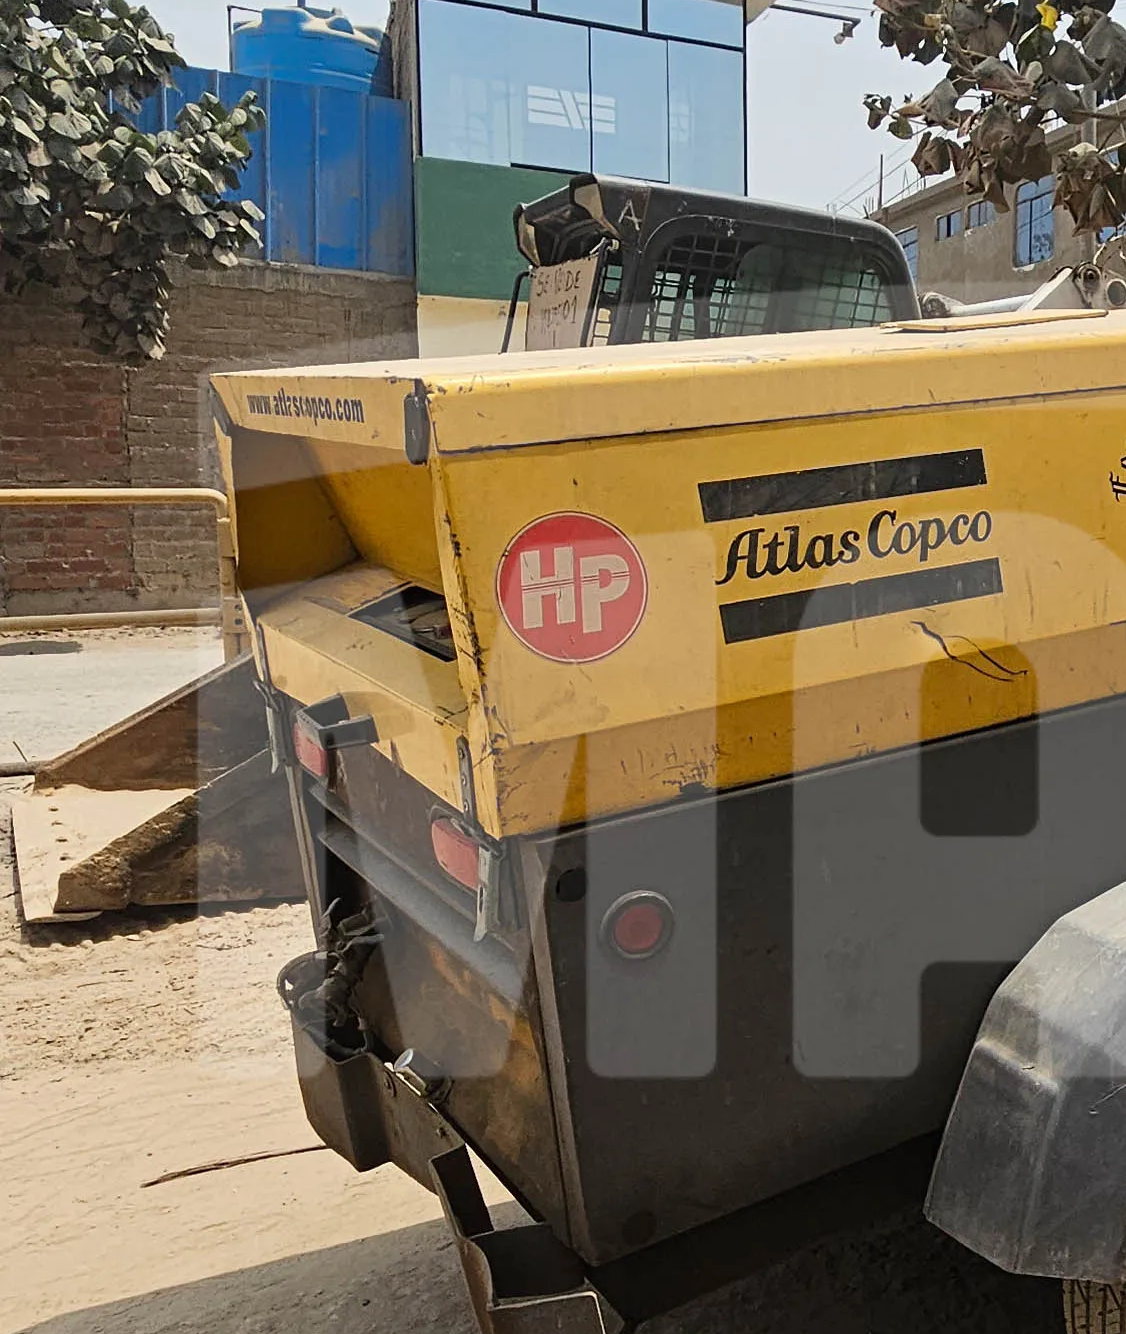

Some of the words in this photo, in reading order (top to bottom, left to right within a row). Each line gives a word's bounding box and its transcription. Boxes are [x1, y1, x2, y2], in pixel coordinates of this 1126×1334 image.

[714, 525, 861, 586] Atlas
[867, 509, 993, 563] Copco
[519, 546, 631, 634] HP
